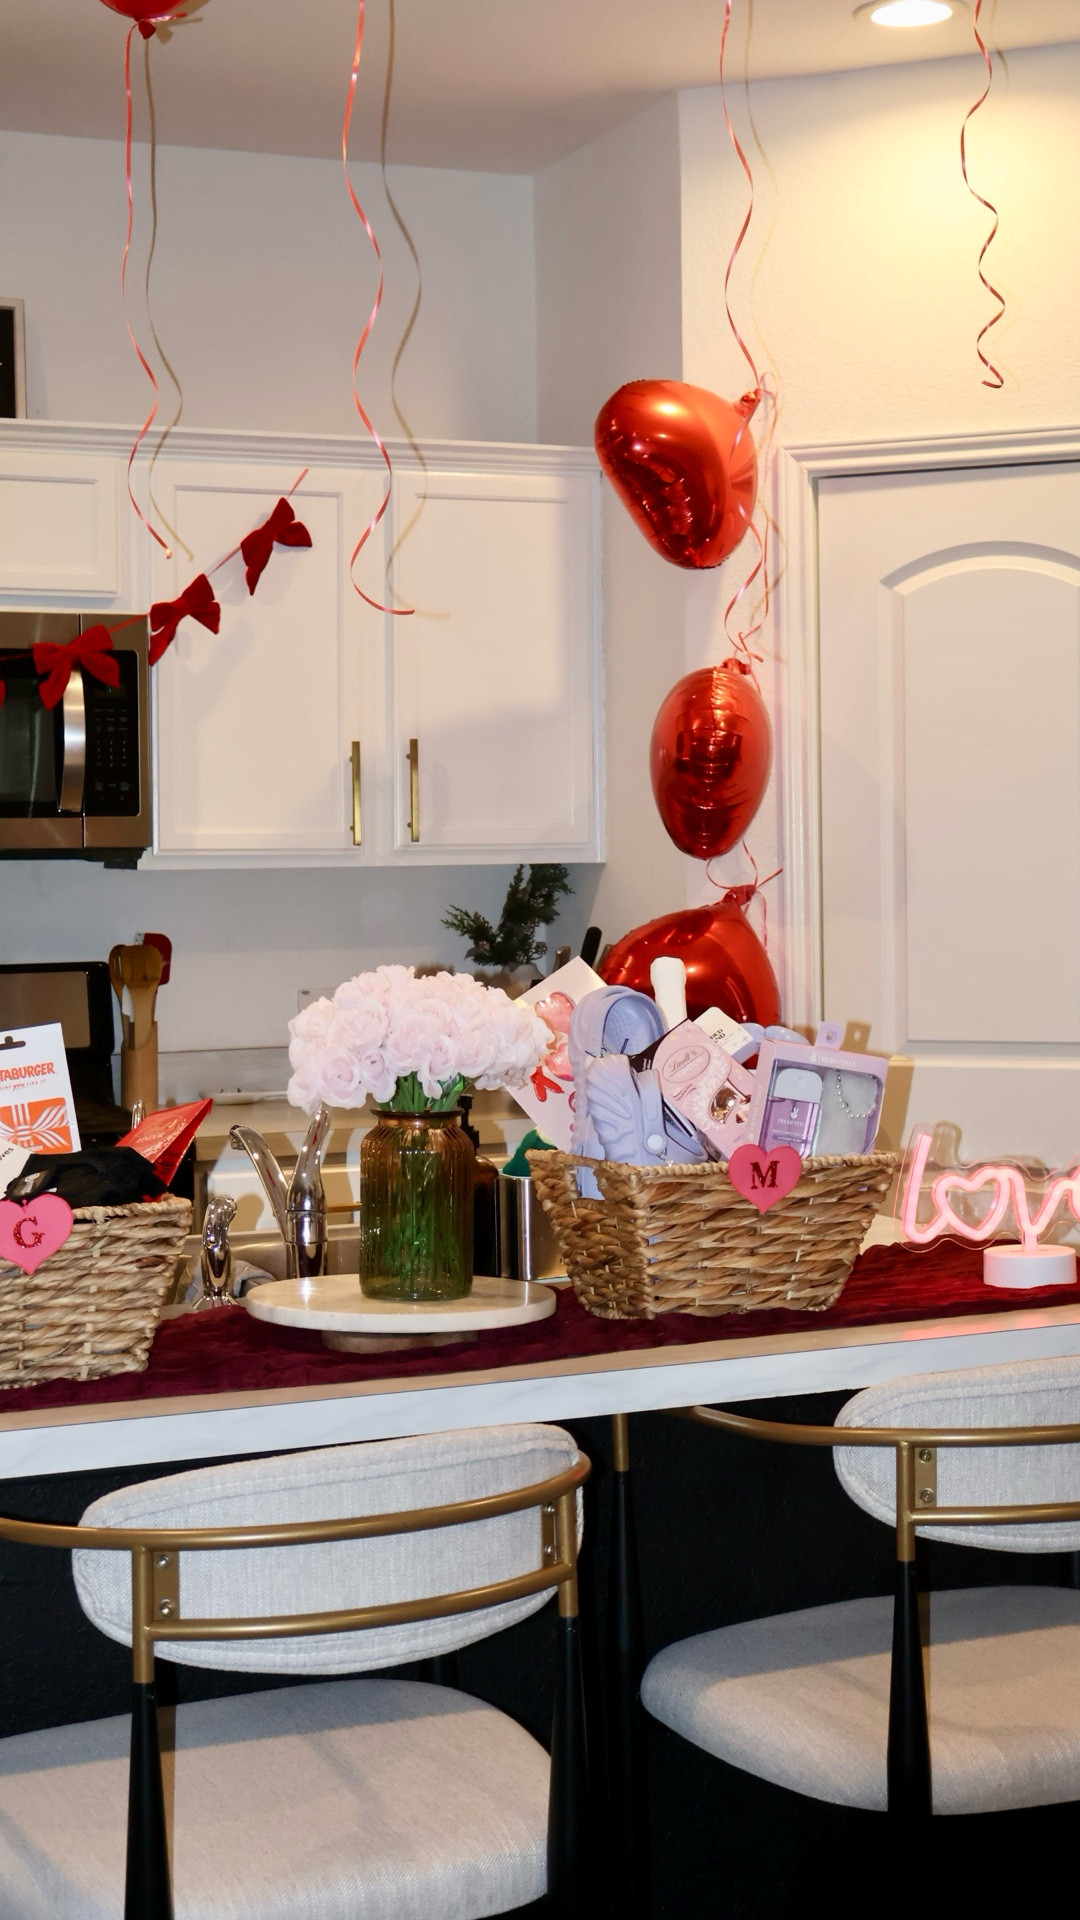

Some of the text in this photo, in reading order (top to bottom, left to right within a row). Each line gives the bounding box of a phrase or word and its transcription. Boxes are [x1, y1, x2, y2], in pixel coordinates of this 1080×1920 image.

[750, 1160, 780, 1190] M
[901, 1131, 1080, 1246] lov
[13, 1215, 46, 1249] G
